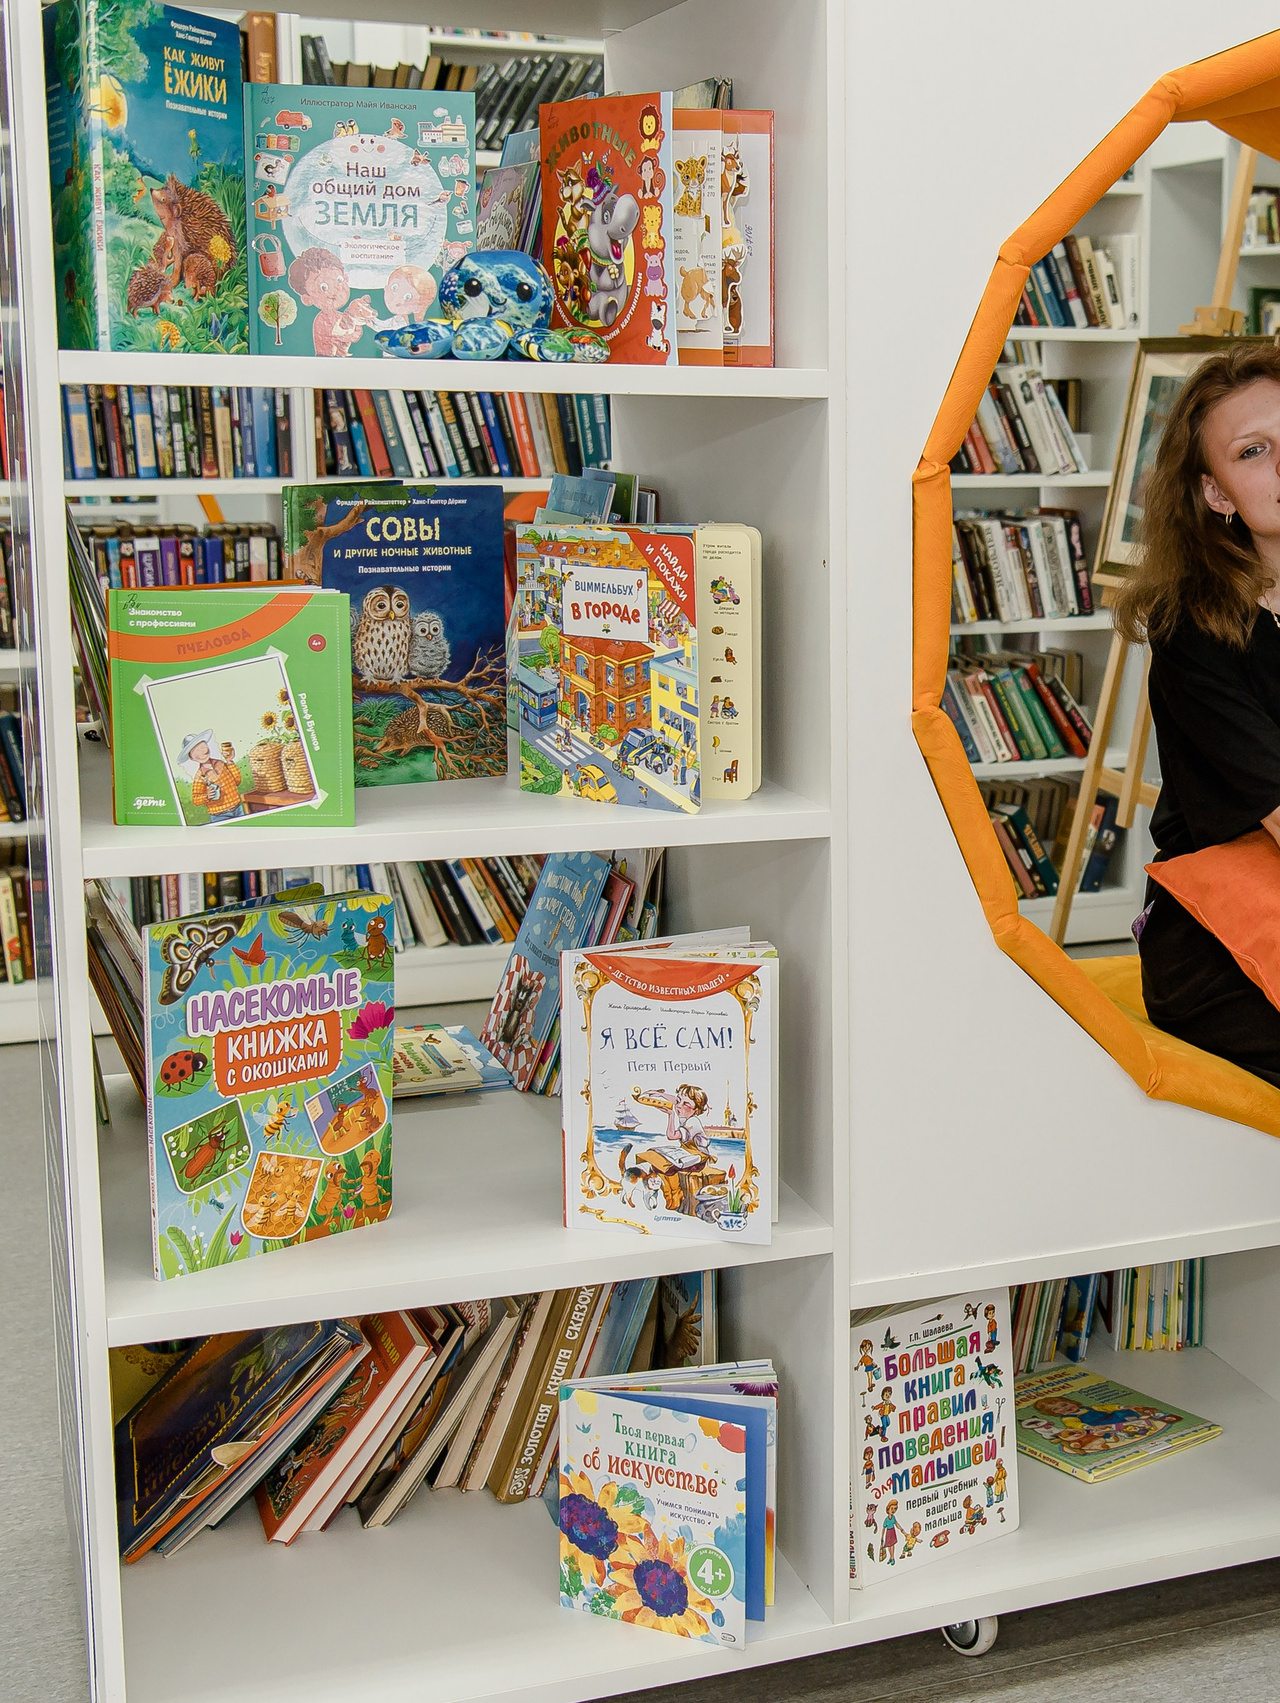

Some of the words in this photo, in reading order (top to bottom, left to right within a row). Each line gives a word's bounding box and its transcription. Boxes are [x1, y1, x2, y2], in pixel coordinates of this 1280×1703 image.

[164, 46, 186, 64] КАК
[190, 52, 225, 72] ЖИВУТ
[164, 61, 227, 105] ЁЖИКИ
[166, 100, 207, 116] Познавательные
[208, 110, 228, 120] истории
[300, 98, 354, 108] Иллюстратор
[356, 100, 378, 110] Майя
[380, 101, 418, 110] Иванская
[546, 122, 638, 175] ЖИВОТНЫЕ
[346, 162, 386, 178] Наш
[312, 178, 377, 198] общий
[383, 184, 421, 200] дом
[314, 200, 418, 228] ЗЕМЛЯ
[344, 242, 400, 252] Экологическое
[350, 252, 394, 260] воспитание
[620, 271, 643, 330] КАРТИНКАМИ
[364, 498, 406, 506] Райхенштеттер
[412, 498, 448, 506] Ханс-Гюнтер
[366, 516, 440, 542] СОВЫ
[334, 549, 340, 558] И
[345, 548, 378, 559] ДРУГИЕ
[382, 547, 418, 557] НОЧНЫЕ
[422, 546, 472, 556] ЖИВОТНЫЕ
[660, 543, 689, 582] НАЙДИ
[358, 565, 420, 574] Познавательные
[422, 564, 452, 572] истории
[645, 544, 654, 556] И
[652, 556, 688, 602] ПОКАЖИ
[574, 580, 634, 596] ВИММЕЛЬБУХ
[128, 606, 182, 617] Знакомство
[136, 619, 196, 629] профессиями
[571, 602, 582, 620] В
[585, 601, 640, 624] ГОРОДЕ
[176, 628, 252, 655] ПЧЕЛОВОД
[298, 692, 313, 720] Ральф
[306, 720, 320, 752] Бучков
[612, 969, 648, 992] ДЕТСТВО
[648, 983, 696, 996] ИЗВЕСТНЫХ
[696, 974, 726, 993] ЛЮДЕЙ
[191, 971, 358, 1033] НАСЕКОМЫЕ
[227, 1019, 328, 1064] КНИЖКА
[600, 1028, 614, 1050] Я
[624, 1023, 668, 1050] ВСЁ
[676, 1027, 732, 1050] САМ!
[226, 1068, 236, 1086] С
[242, 1050, 329, 1083] ОКОШКАМИ
[628, 1061, 656, 1072] Петя
[664, 1060, 712, 1074] Первый
[910, 1332, 922, 1342] Г.П.
[922, 1322, 954, 1339] Шалаева
[884, 1331, 981, 1382] Большая
[520, 1403, 552, 1464] ЗОЛОТАЯ
[544, 1348, 572, 1396] КНИГА
[564, 1284, 596, 1340] СКАЗОК
[904, 1364, 965, 1404] книга
[1014, 1372, 1090, 1399] оспитанный
[898, 1388, 976, 1434] правил
[612, 1413, 642, 1438] Твоя
[646, 1430, 684, 1448] первая
[878, 1411, 994, 1470] поведения
[625, 1440, 676, 1466] книга
[584, 1447, 601, 1470] об
[607, 1455, 718, 1498] искусстве
[870, 1477, 894, 1500] для
[891, 1434, 997, 1495] малышей
[906, 1489, 940, 1512] Первый
[944, 1476, 979, 1500] учебник
[656, 1498, 683, 1510] Учимся
[684, 1505, 720, 1519] понимать
[670, 1511, 706, 1526] искусство
[924, 1510, 962, 1532] малыша
[926, 1499, 957, 1517] вашего
[697, 1558, 726, 1585] 4+
